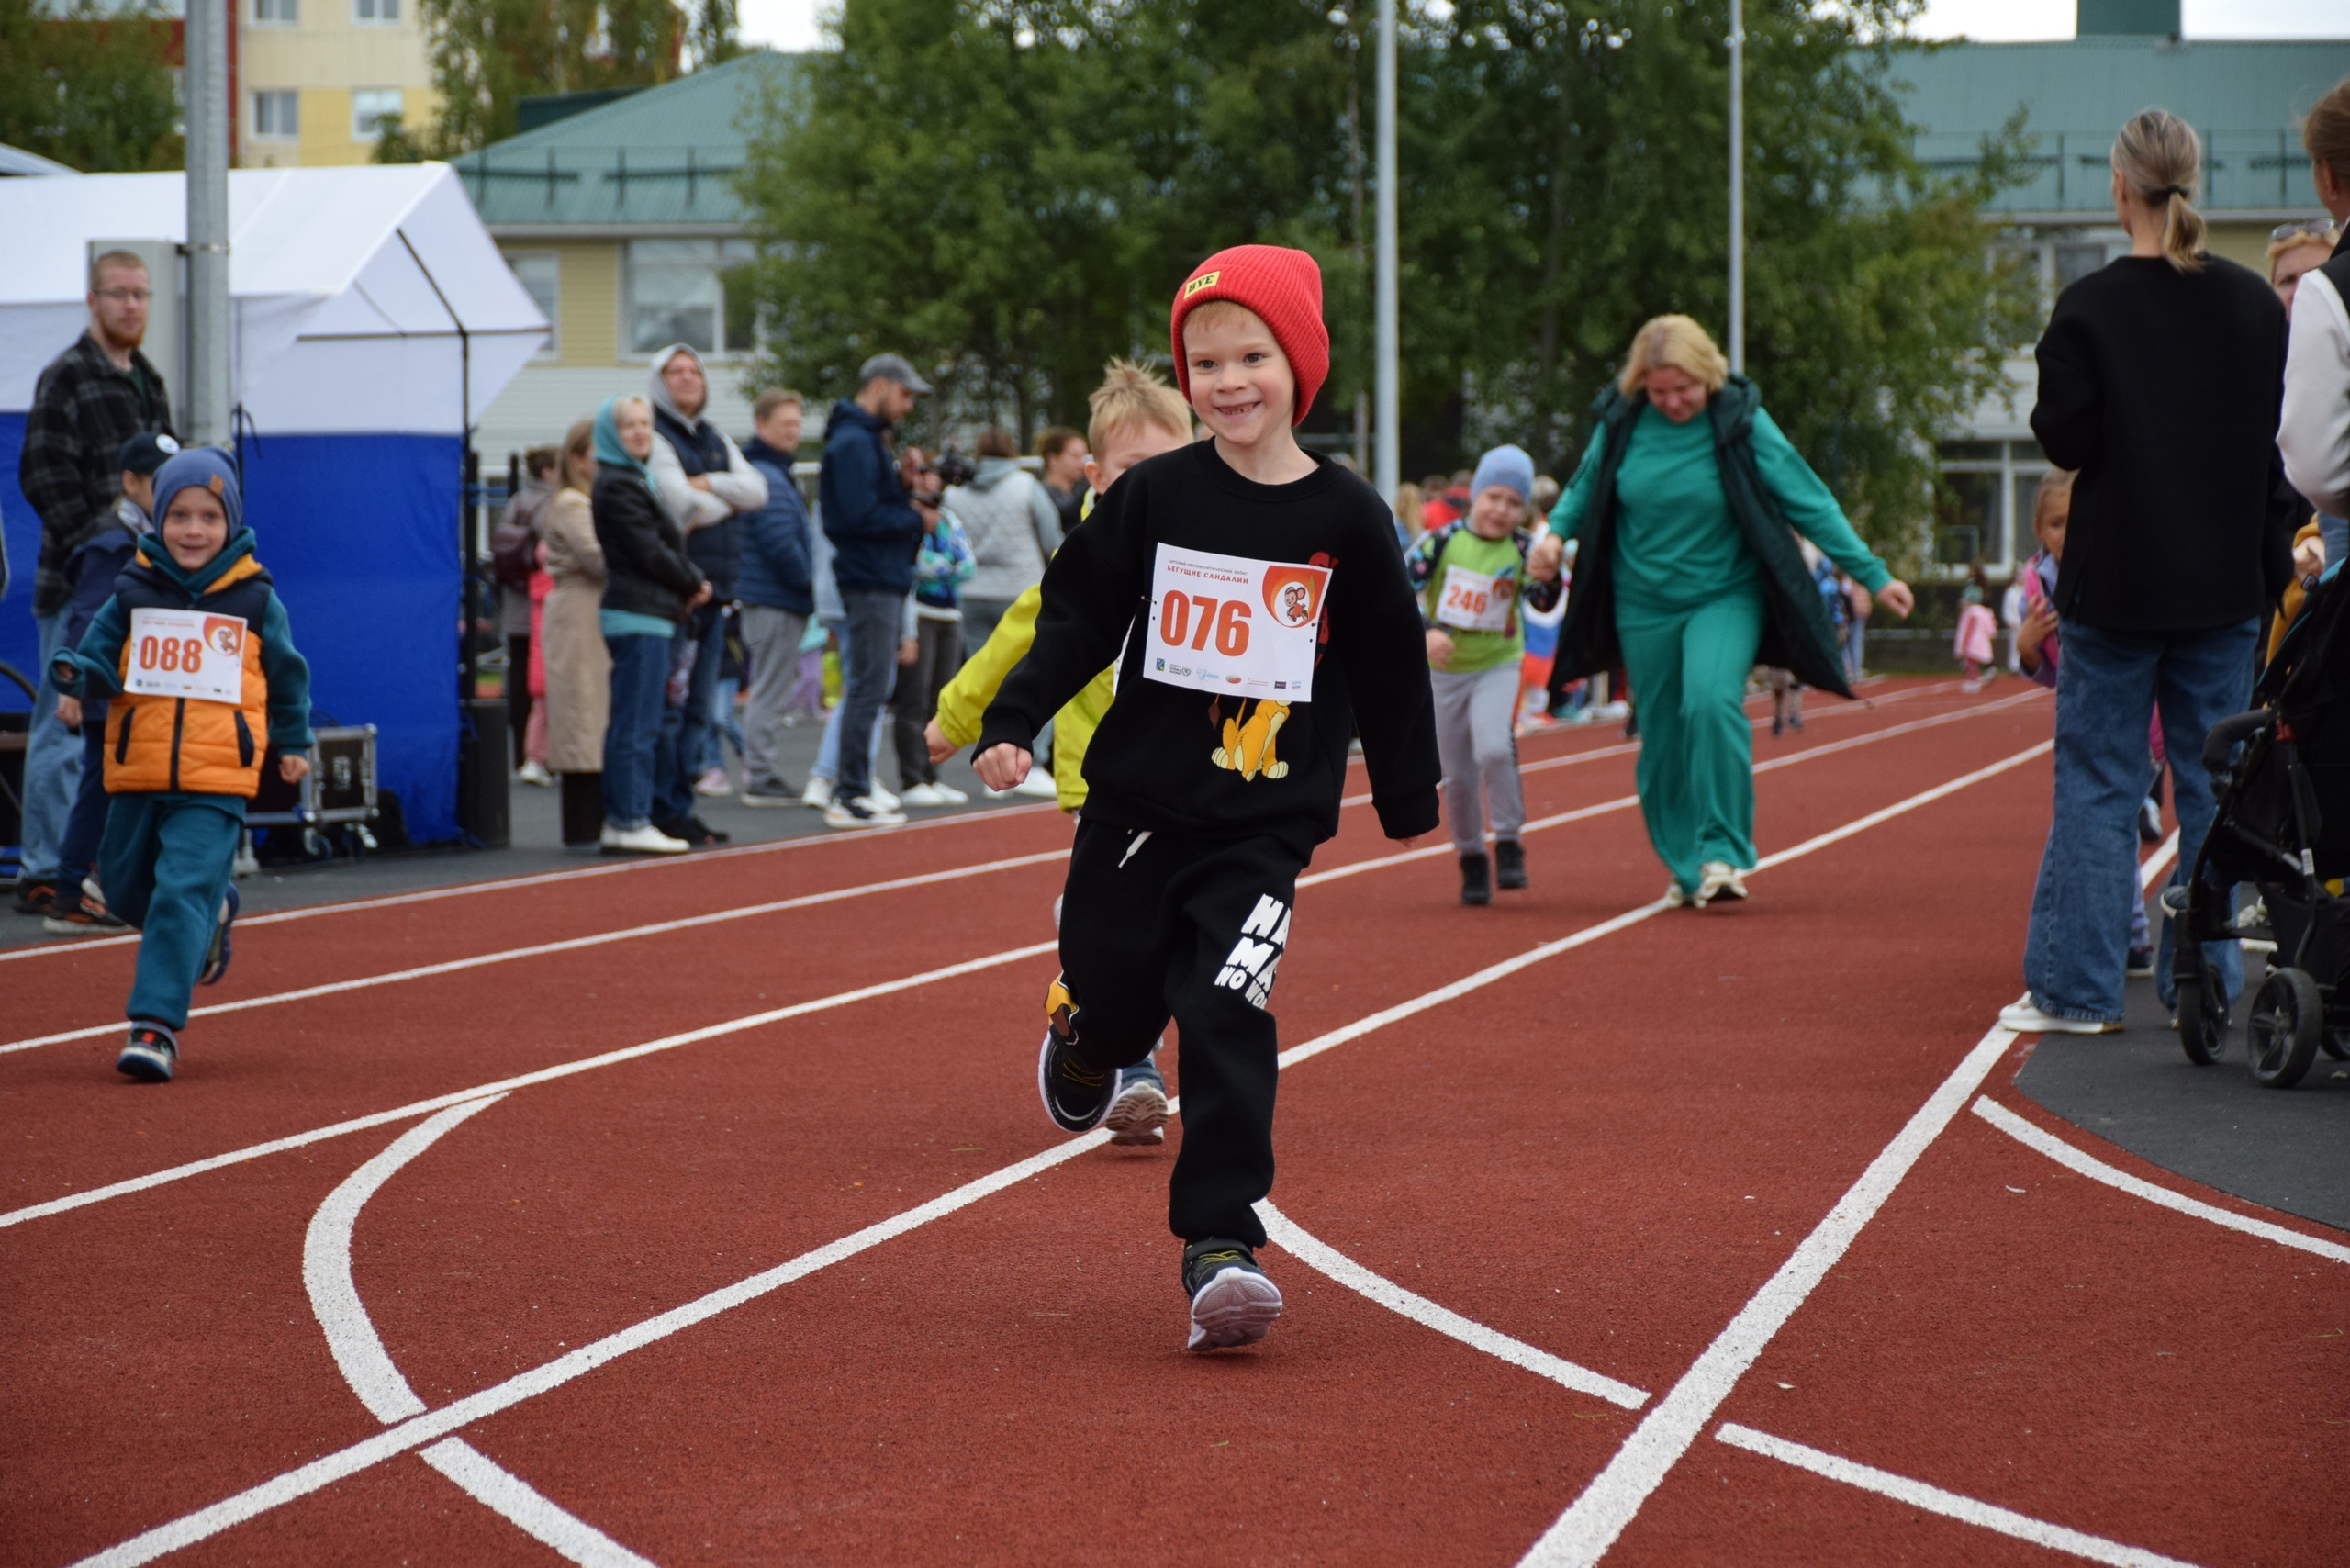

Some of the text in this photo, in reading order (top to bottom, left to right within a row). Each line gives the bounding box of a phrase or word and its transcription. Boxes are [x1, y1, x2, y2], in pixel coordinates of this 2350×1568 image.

[1167, 565, 1249, 585] БЕГУЩИЕ САНДАЛИИ
[1447, 583, 1488, 615] 246
[1160, 590, 1252, 656] 076
[140, 634, 204, 674] 088
[1214, 966, 1248, 990] NO
